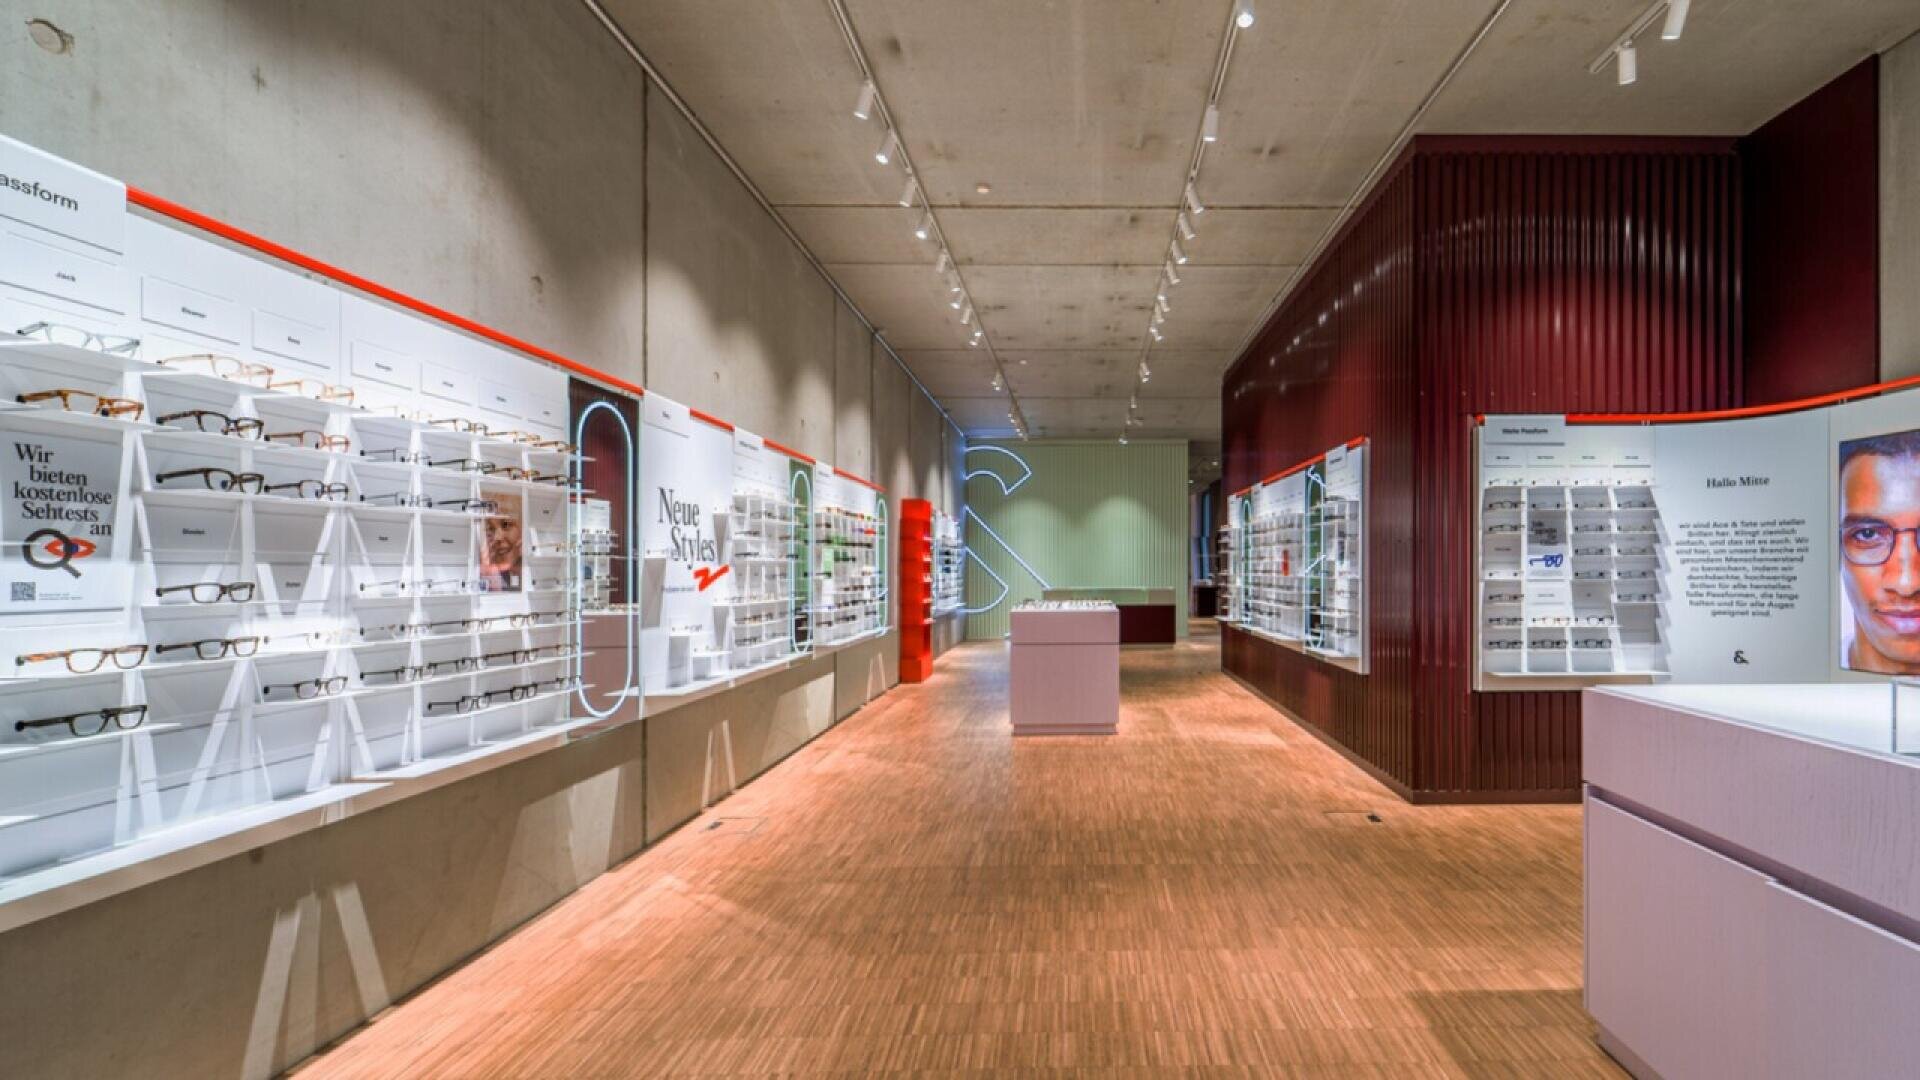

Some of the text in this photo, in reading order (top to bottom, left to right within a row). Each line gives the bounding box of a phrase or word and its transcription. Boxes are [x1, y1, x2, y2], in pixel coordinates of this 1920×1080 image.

[14, 442, 55, 463] Wir
[29, 465, 88, 486] bieten
[1706, 476, 1770, 488] Hallo Mitte
[14, 481, 113, 505] kostenlose
[22, 501, 99, 522] Sehtests
[658, 486, 701, 526] Neue
[89, 523, 112, 536] an
[1760, 519, 1777, 528] und
[671, 526, 716, 570] Styles
[1708, 538, 1726, 546] und
[1727, 537, 1744, 546] das
[1734, 650, 1750, 664] &
